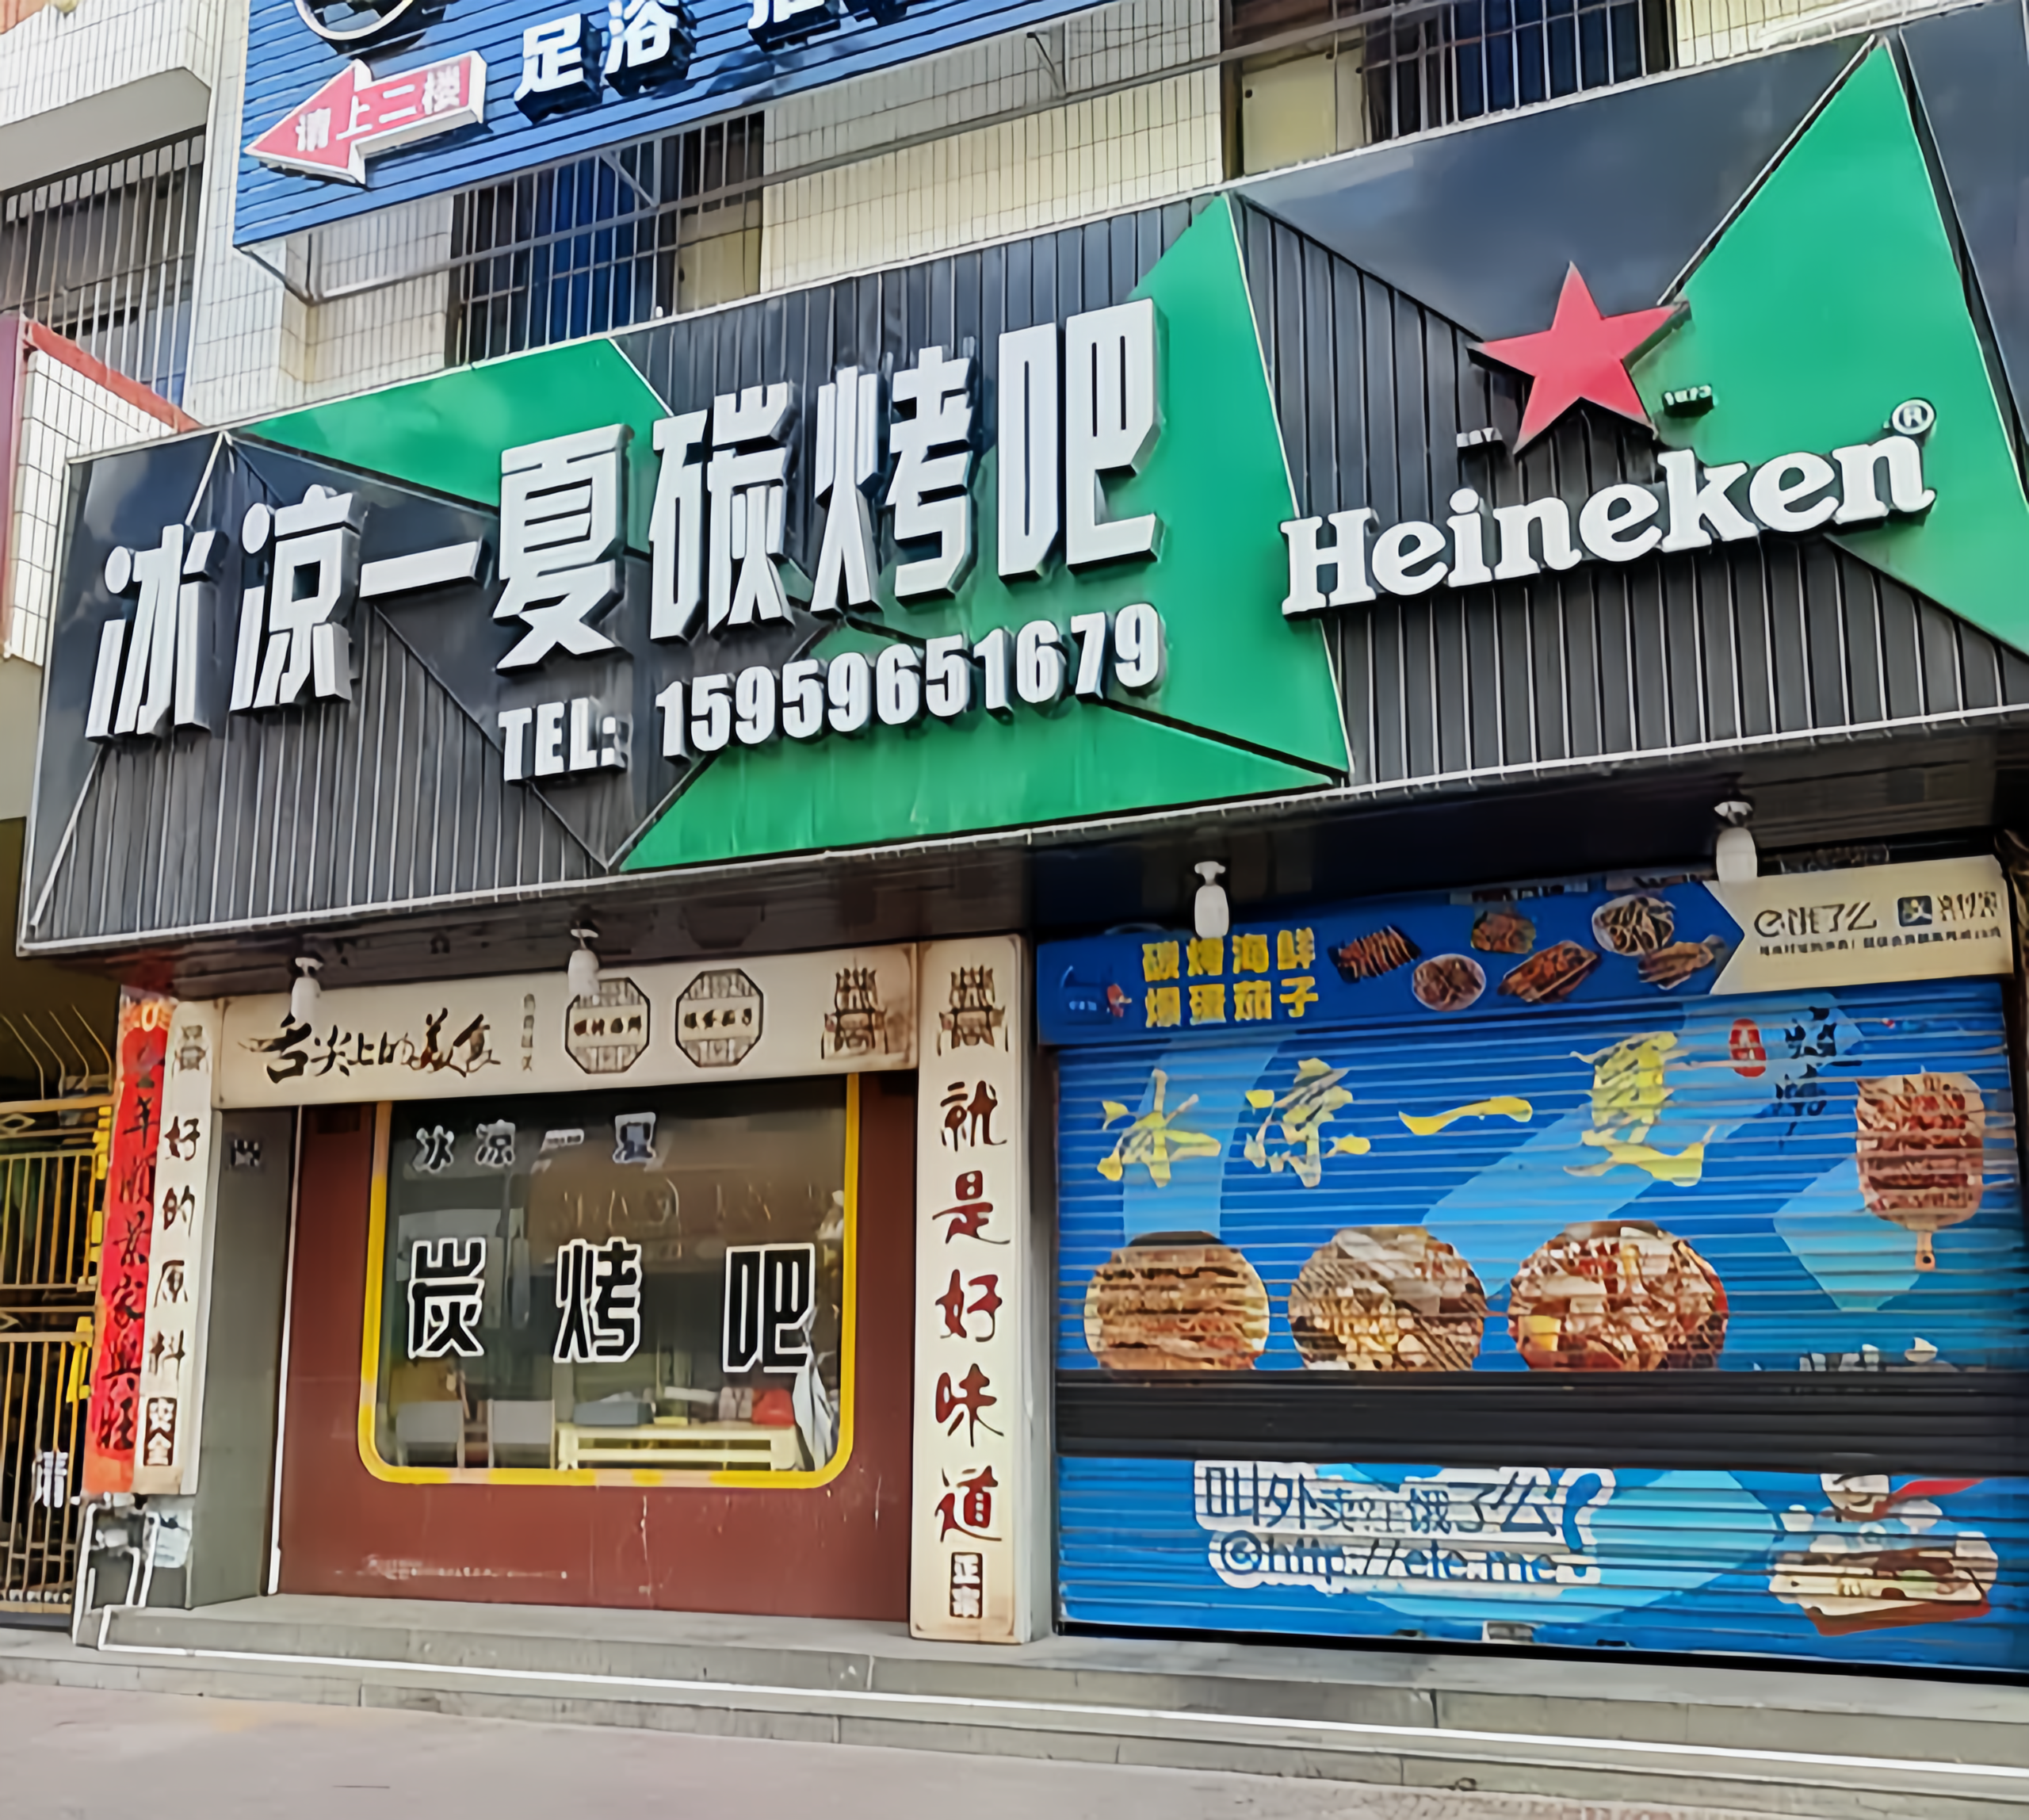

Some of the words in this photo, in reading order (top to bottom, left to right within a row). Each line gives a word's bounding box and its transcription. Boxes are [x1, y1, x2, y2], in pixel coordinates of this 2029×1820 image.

[85, 296, 1162, 742] 冰凉一夏碳烤吧
[1280, 434, 1937, 617] Heineken
[498, 697, 628, 782] TEL:
[655, 602, 1164, 761] 15959651679
[407, 1237, 816, 1374] 炭烤吧
[932, 1080, 1011, 1543] 就是好味道
